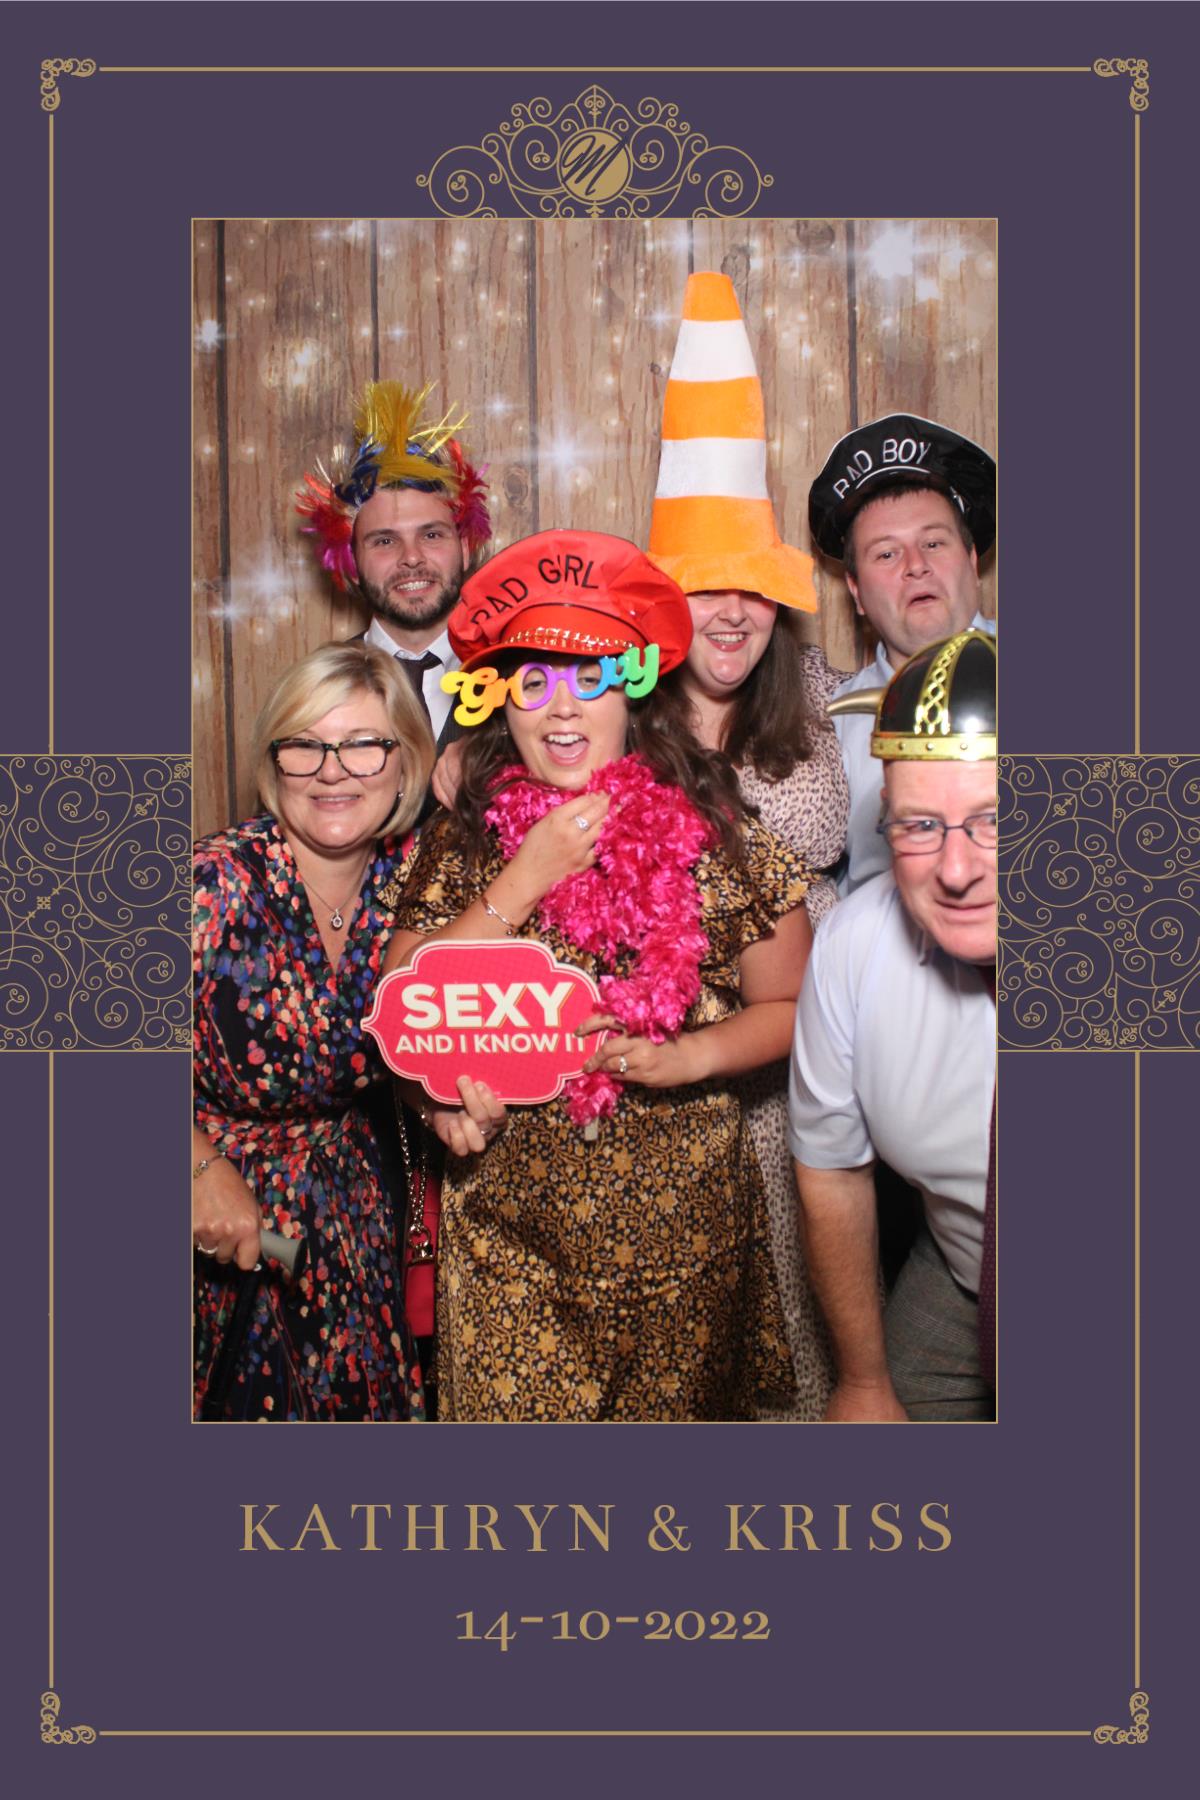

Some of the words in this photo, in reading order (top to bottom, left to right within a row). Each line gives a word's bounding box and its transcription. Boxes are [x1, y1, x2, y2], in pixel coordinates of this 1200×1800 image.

[882, 438, 932, 465] BOY
[401, 981, 576, 1030] SEXY
[395, 1034, 454, 1054] AND
[460, 1033, 468, 1054] I
[473, 1032, 559, 1054] KNOW
